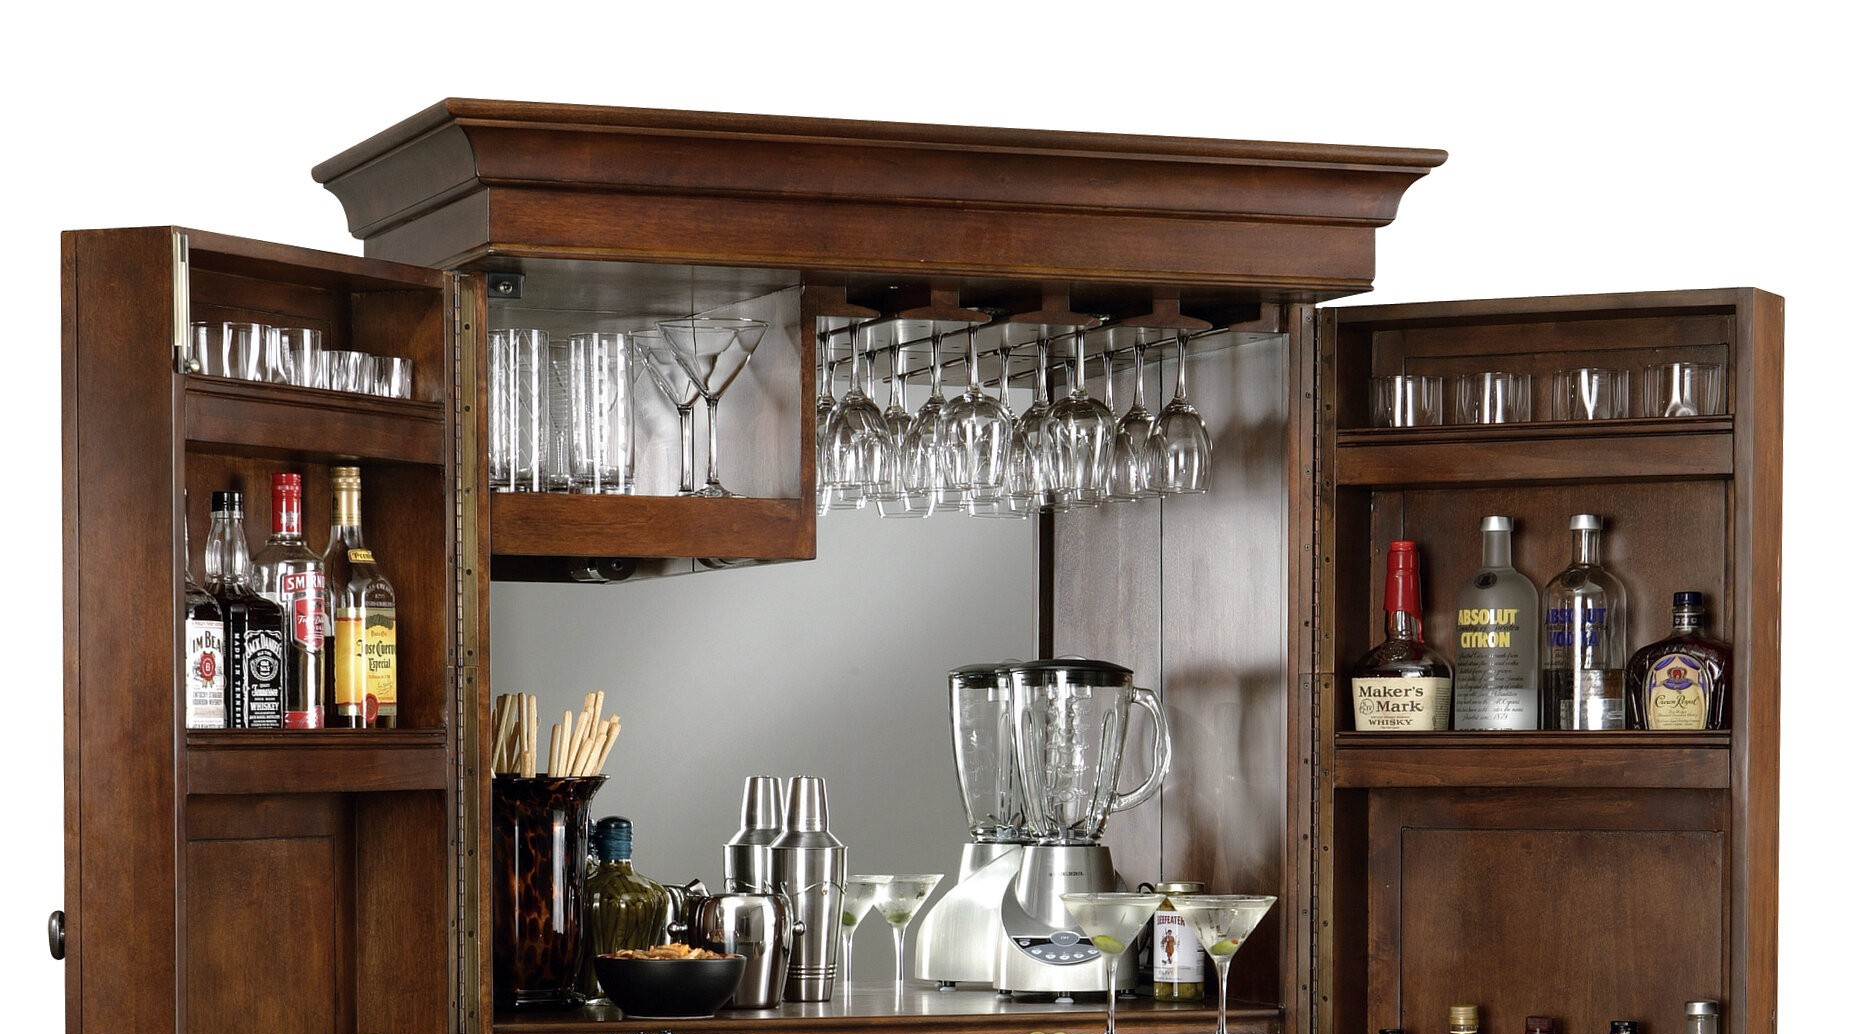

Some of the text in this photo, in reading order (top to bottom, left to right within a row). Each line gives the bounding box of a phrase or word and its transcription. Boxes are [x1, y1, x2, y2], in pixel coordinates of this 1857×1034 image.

[1457, 608, 1518, 626] ABSOLUT
[233, 632, 241, 660] MADE
[1460, 631, 1511, 649] CITRON
[234, 664, 241, 676] IN
[368, 657, 391, 672] Especial
[1359, 685, 1424, 698] Maker's
[249, 701, 280, 711] WHISKEY
[1376, 700, 1424, 713] Mark
[1368, 718, 1413, 726] WHISKY
